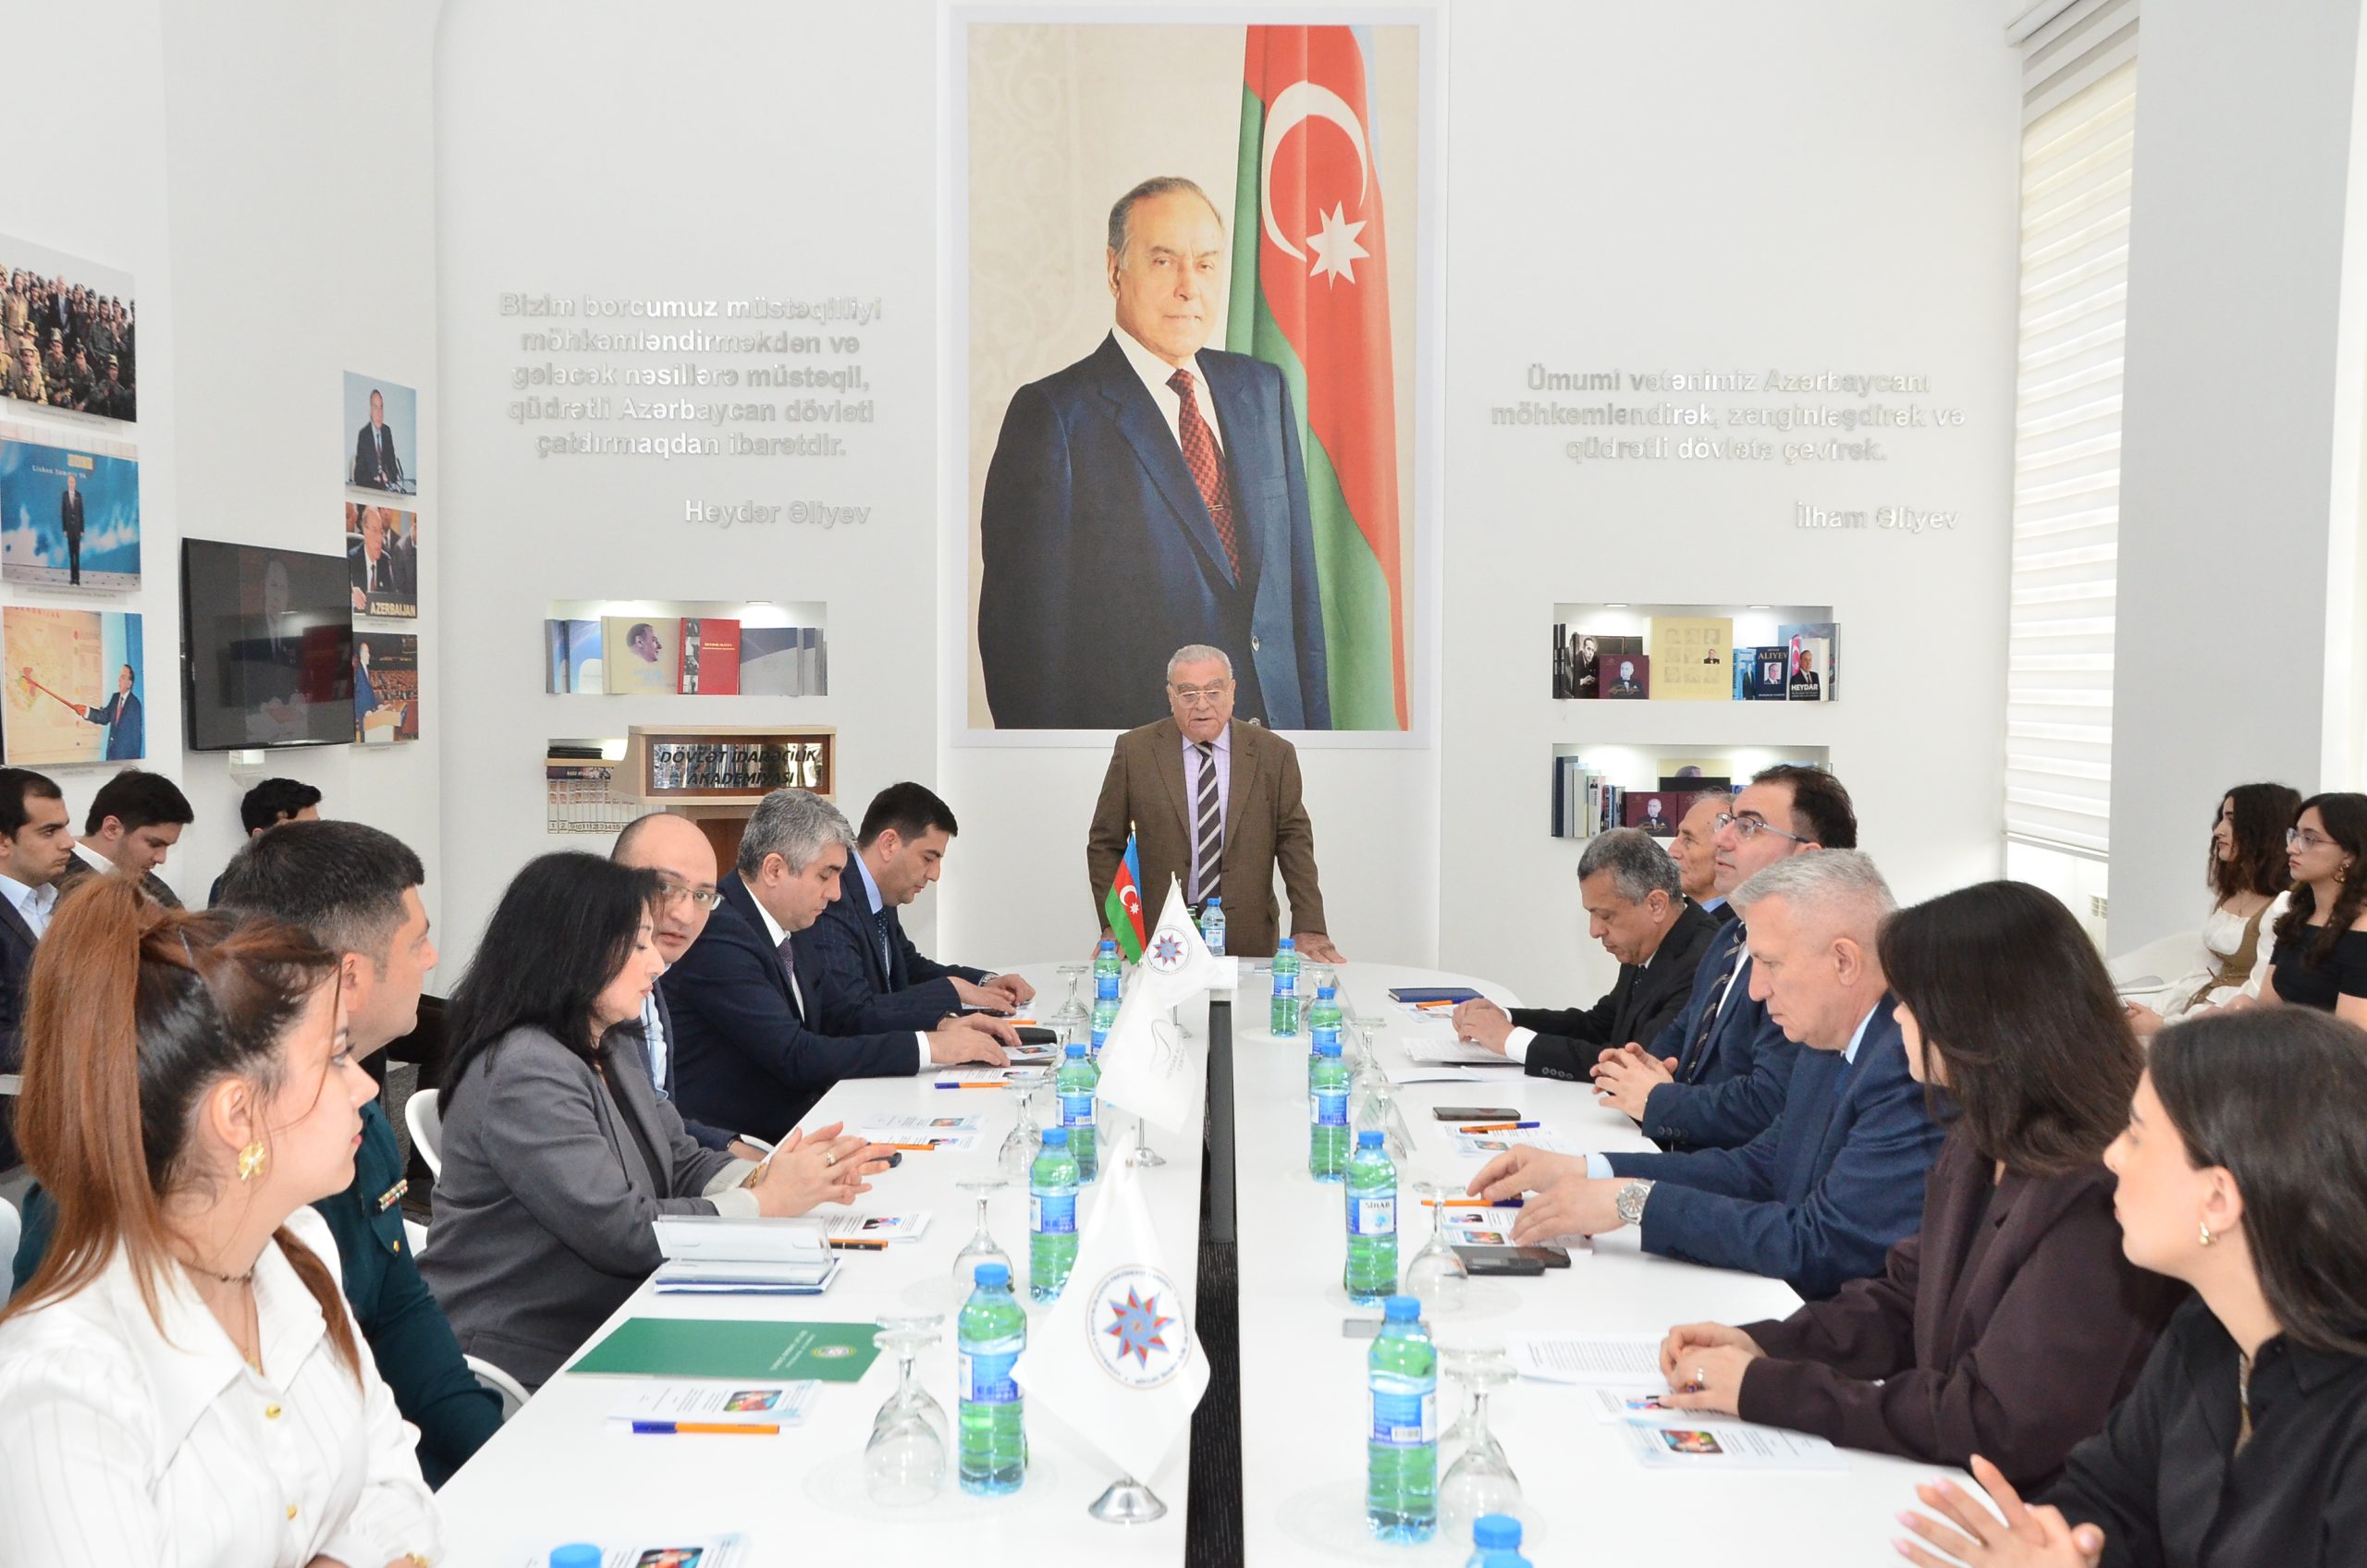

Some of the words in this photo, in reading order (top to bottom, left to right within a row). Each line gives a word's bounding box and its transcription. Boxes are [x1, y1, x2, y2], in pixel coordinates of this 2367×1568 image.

[499, 292, 575, 318] Bizim
[584, 294, 718, 318] borcumuz
[727, 296, 882, 326] müstəqilliyi
[521, 328, 821, 355] möhkəmləndirməkdən
[828, 336, 860, 355] və
[510, 362, 619, 390] gələcək
[625, 362, 739, 387] nəsillərə
[746, 363, 871, 393] müstəqil,
[1526, 362, 1622, 393] Ümumi
[1629, 370, 1759, 392] vətənimiz
[1763, 370, 1932, 398] Azərbaycanı
[507, 396, 611, 425] qüdrətli
[617, 397, 776, 426] Azərbaycan
[785, 399, 875, 423] dövləti
[1490, 401, 1720, 431] möhkəmləndirək,
[1727, 402, 1927, 434] zənginləşdirək
[1934, 409, 1966, 427] və
[534, 431, 720, 460] çatdırmaqdan
[728, 432, 848, 457] ibarətdir.
[1565, 435, 1670, 465] qüdrətli
[1677, 436, 1775, 460] dövlətə
[1783, 437, 1888, 466] çevirək.
[684, 499, 781, 530] Heydər
[789, 500, 871, 530] Əliyev
[1795, 500, 1869, 530] İlham
[1876, 503, 1960, 534] Əliyev
[370, 602, 416, 617] AZERBAIJAN
[1758, 652, 1789, 660] ALIYEV
[659, 746, 728, 763] DÖVLƏT
[686, 769, 795, 786] AKADEMİYASI
